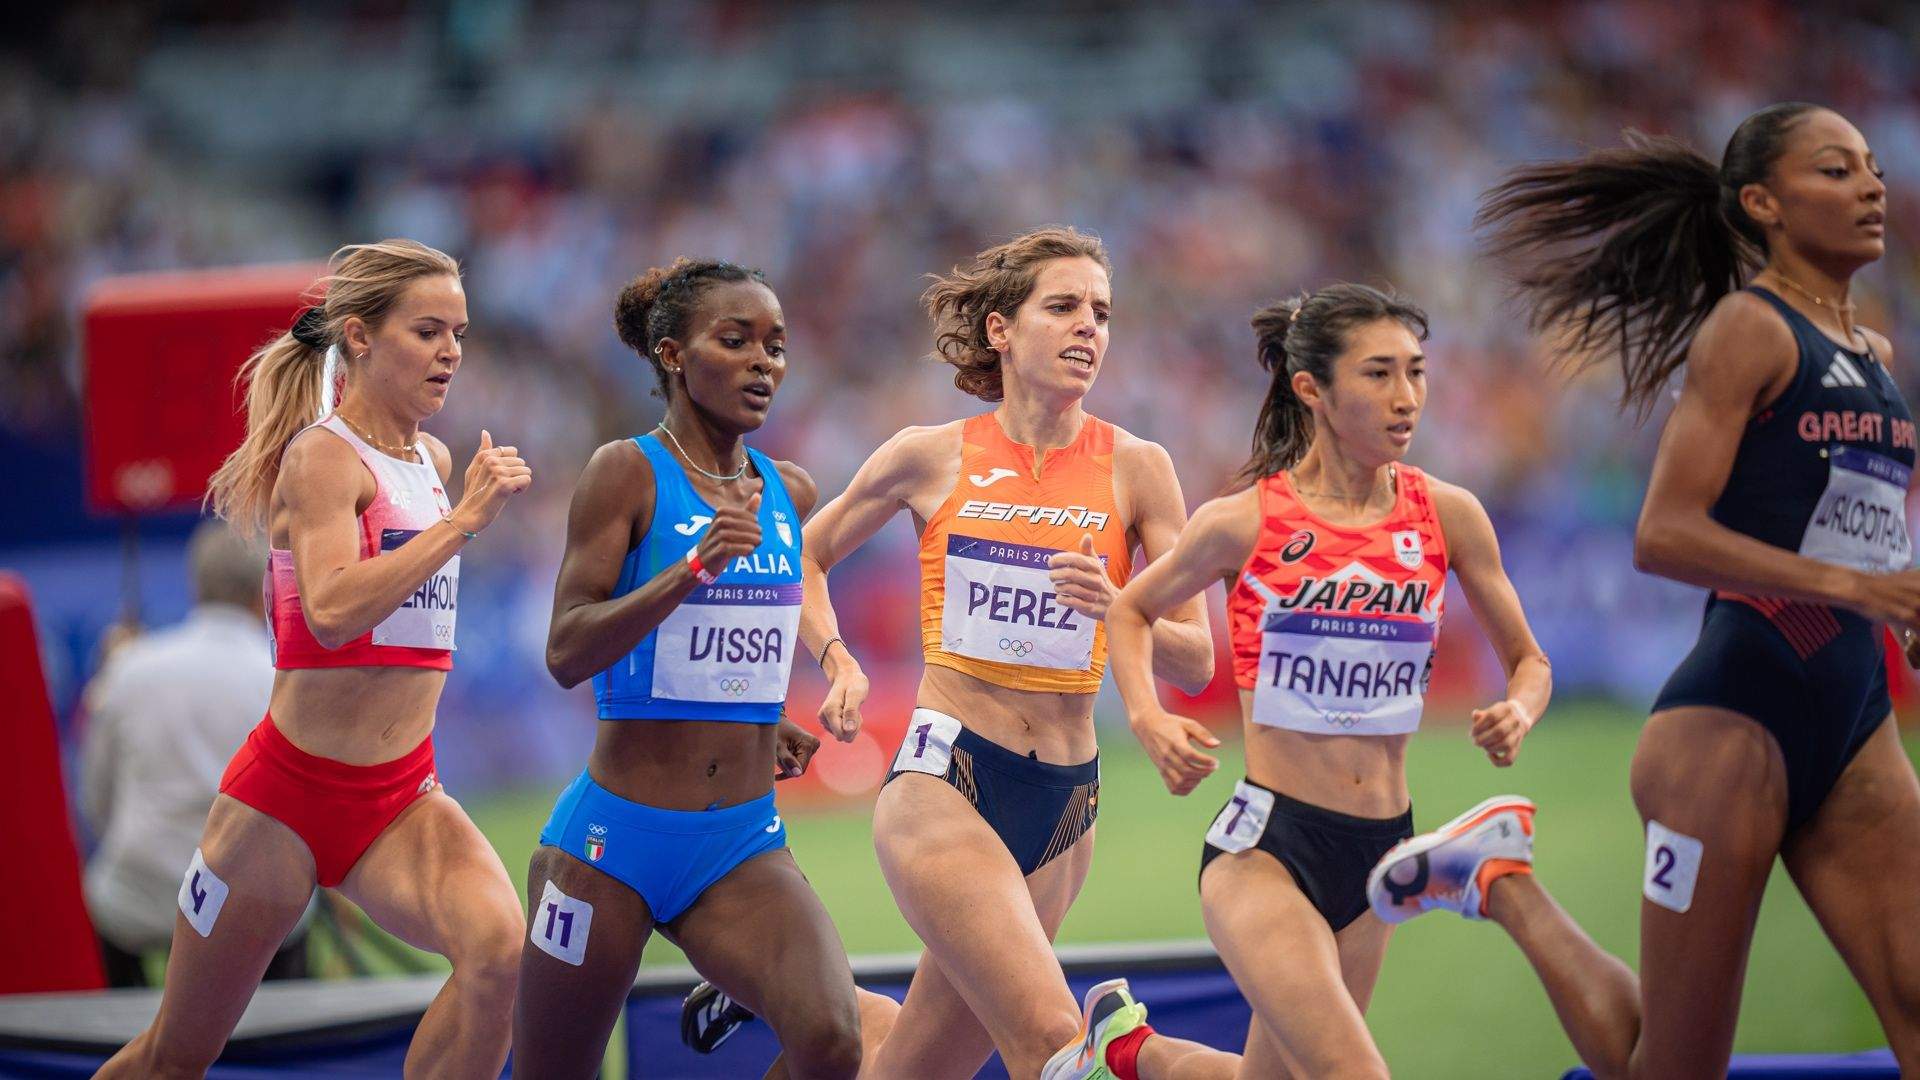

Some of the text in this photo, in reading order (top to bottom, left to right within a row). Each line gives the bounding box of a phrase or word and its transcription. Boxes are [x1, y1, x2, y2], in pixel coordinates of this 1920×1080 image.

[1798, 410, 1883, 442] GREAT
[957, 500, 1109, 531] ESPAÑA
[723, 553, 793, 576] ALIA
[989, 546, 1029, 561] PARIS
[706, 588, 778, 600] PARIS 2024
[967, 581, 1078, 631] PEREZ
[1279, 579, 1428, 614] JAPAN
[689, 626, 782, 663] VISSA
[1311, 618, 1398, 637] PARIS 2024
[1268, 651, 1415, 698] TANAKA
[914, 723, 933, 758] 1
[1652, 846, 1675, 890] 2
[191, 868, 207, 916] 4
[545, 902, 574, 949] 11
